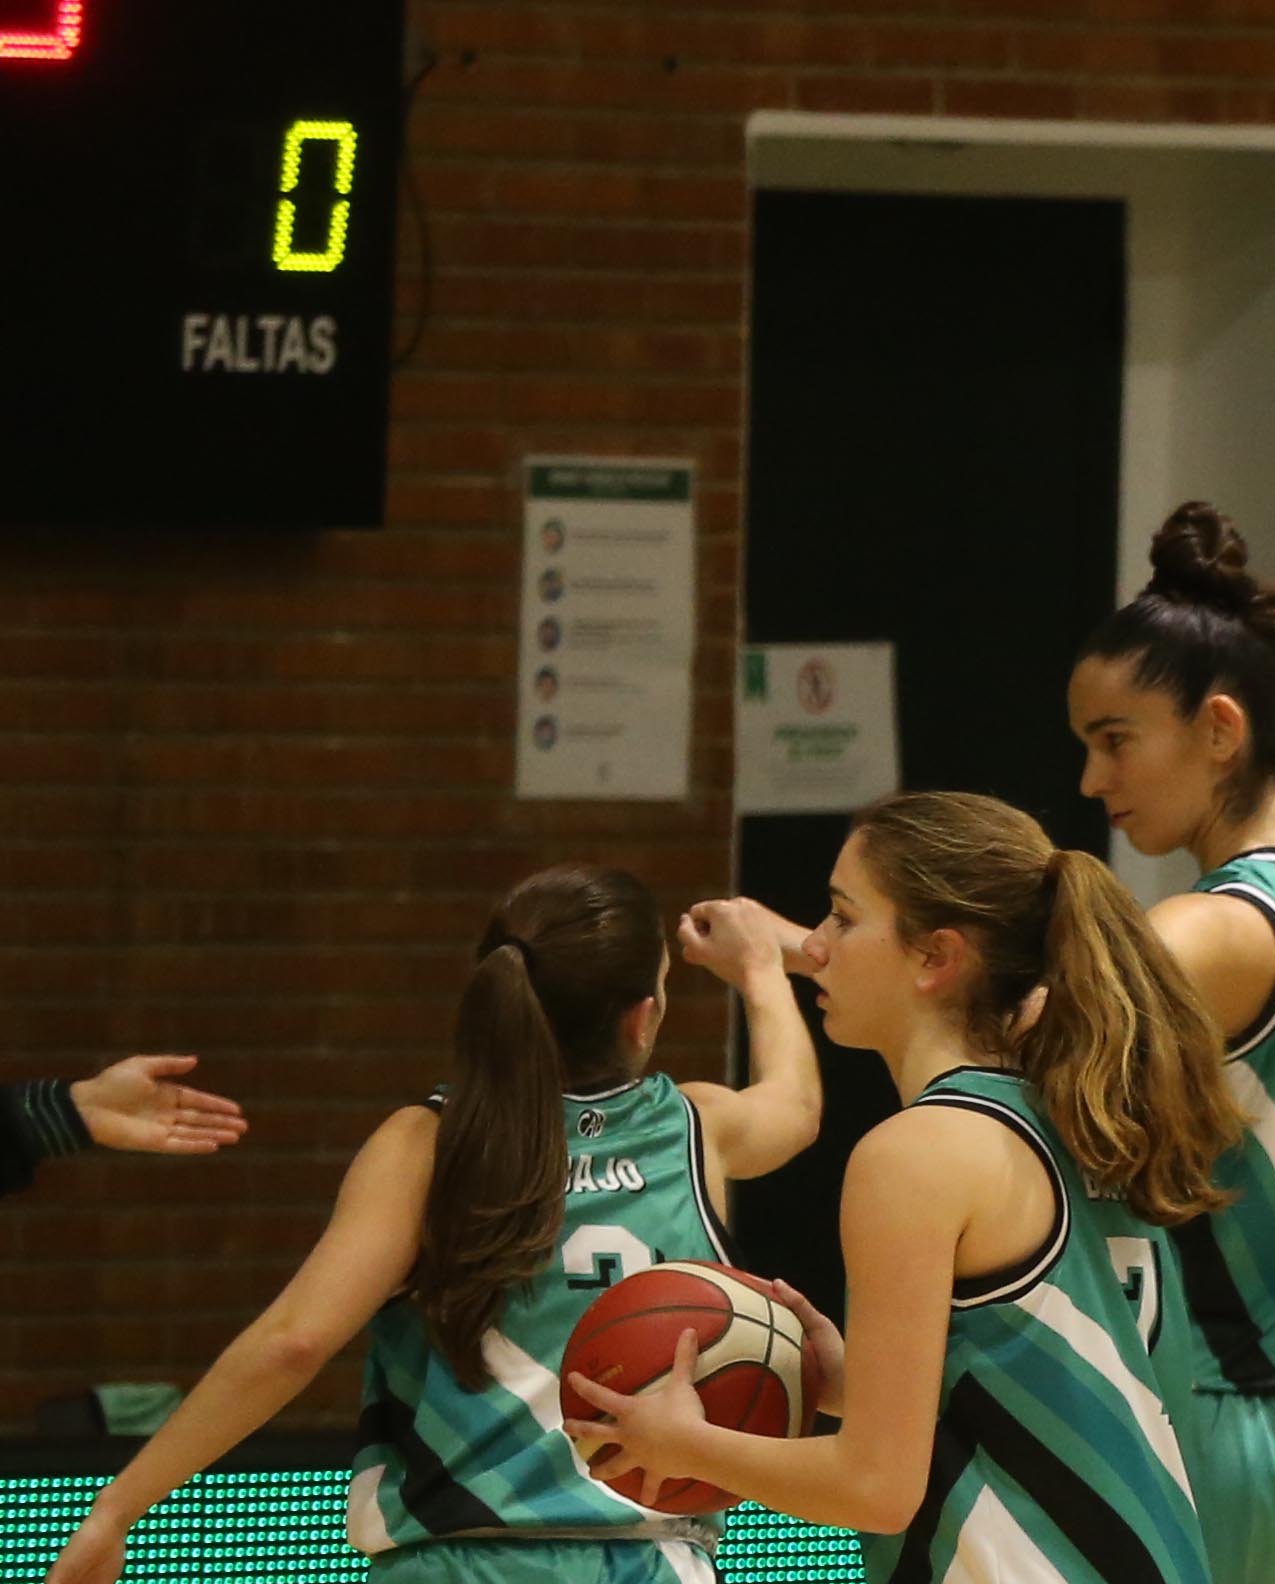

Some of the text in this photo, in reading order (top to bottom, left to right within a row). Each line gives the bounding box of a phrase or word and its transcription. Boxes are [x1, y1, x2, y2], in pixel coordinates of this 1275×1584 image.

[273, 120, 358, 272] 0
[181, 314, 338, 373] FALTAS
[565, 1153, 646, 1193] AJO
